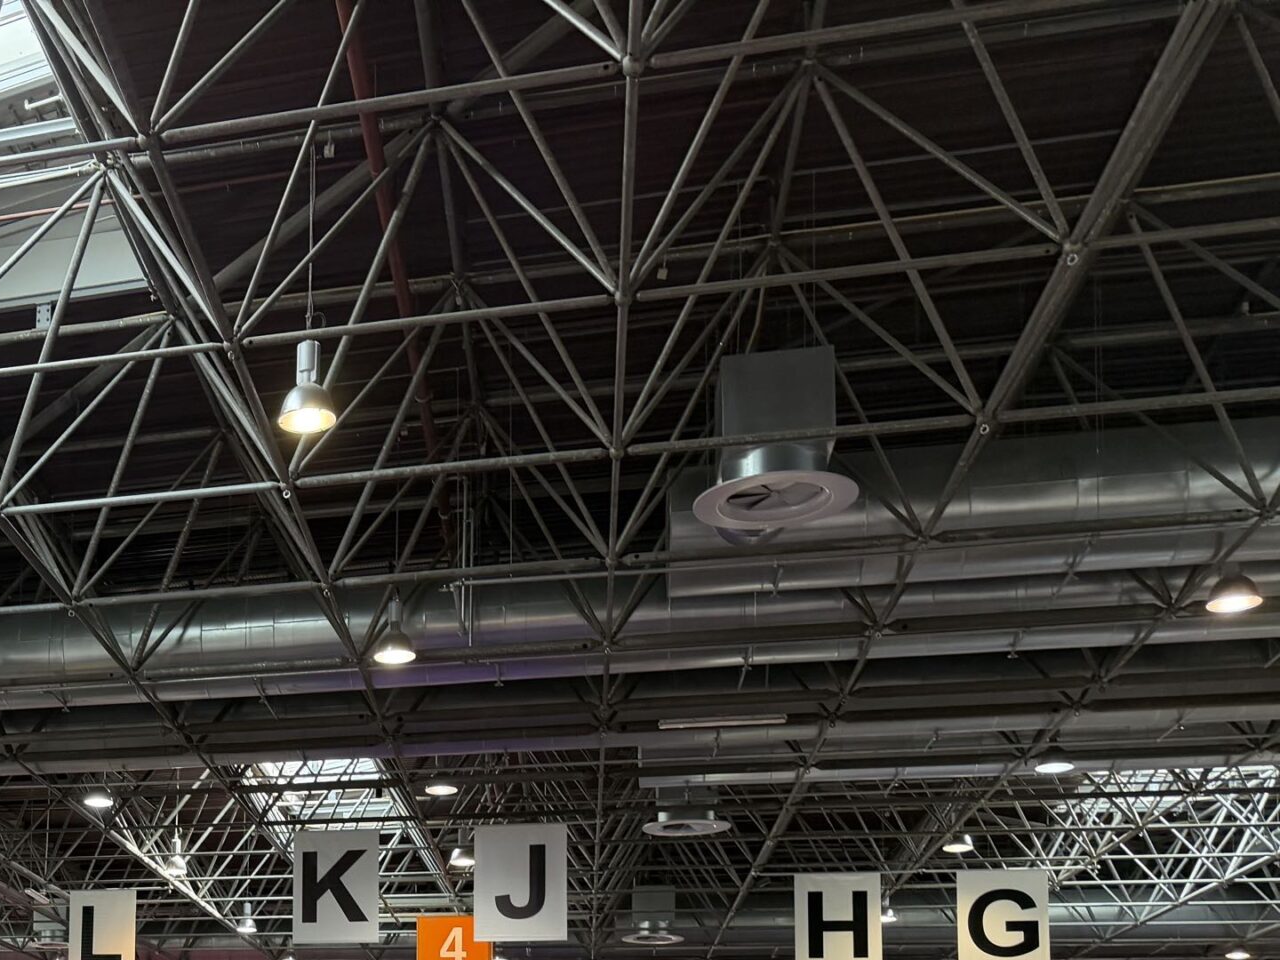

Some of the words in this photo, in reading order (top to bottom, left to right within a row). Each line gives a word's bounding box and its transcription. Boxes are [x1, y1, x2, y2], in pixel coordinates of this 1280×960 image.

[301, 849, 369, 924] K
[495, 844, 546, 920] J
[807, 891, 869, 959] H
[968, 889, 1041, 958] G
